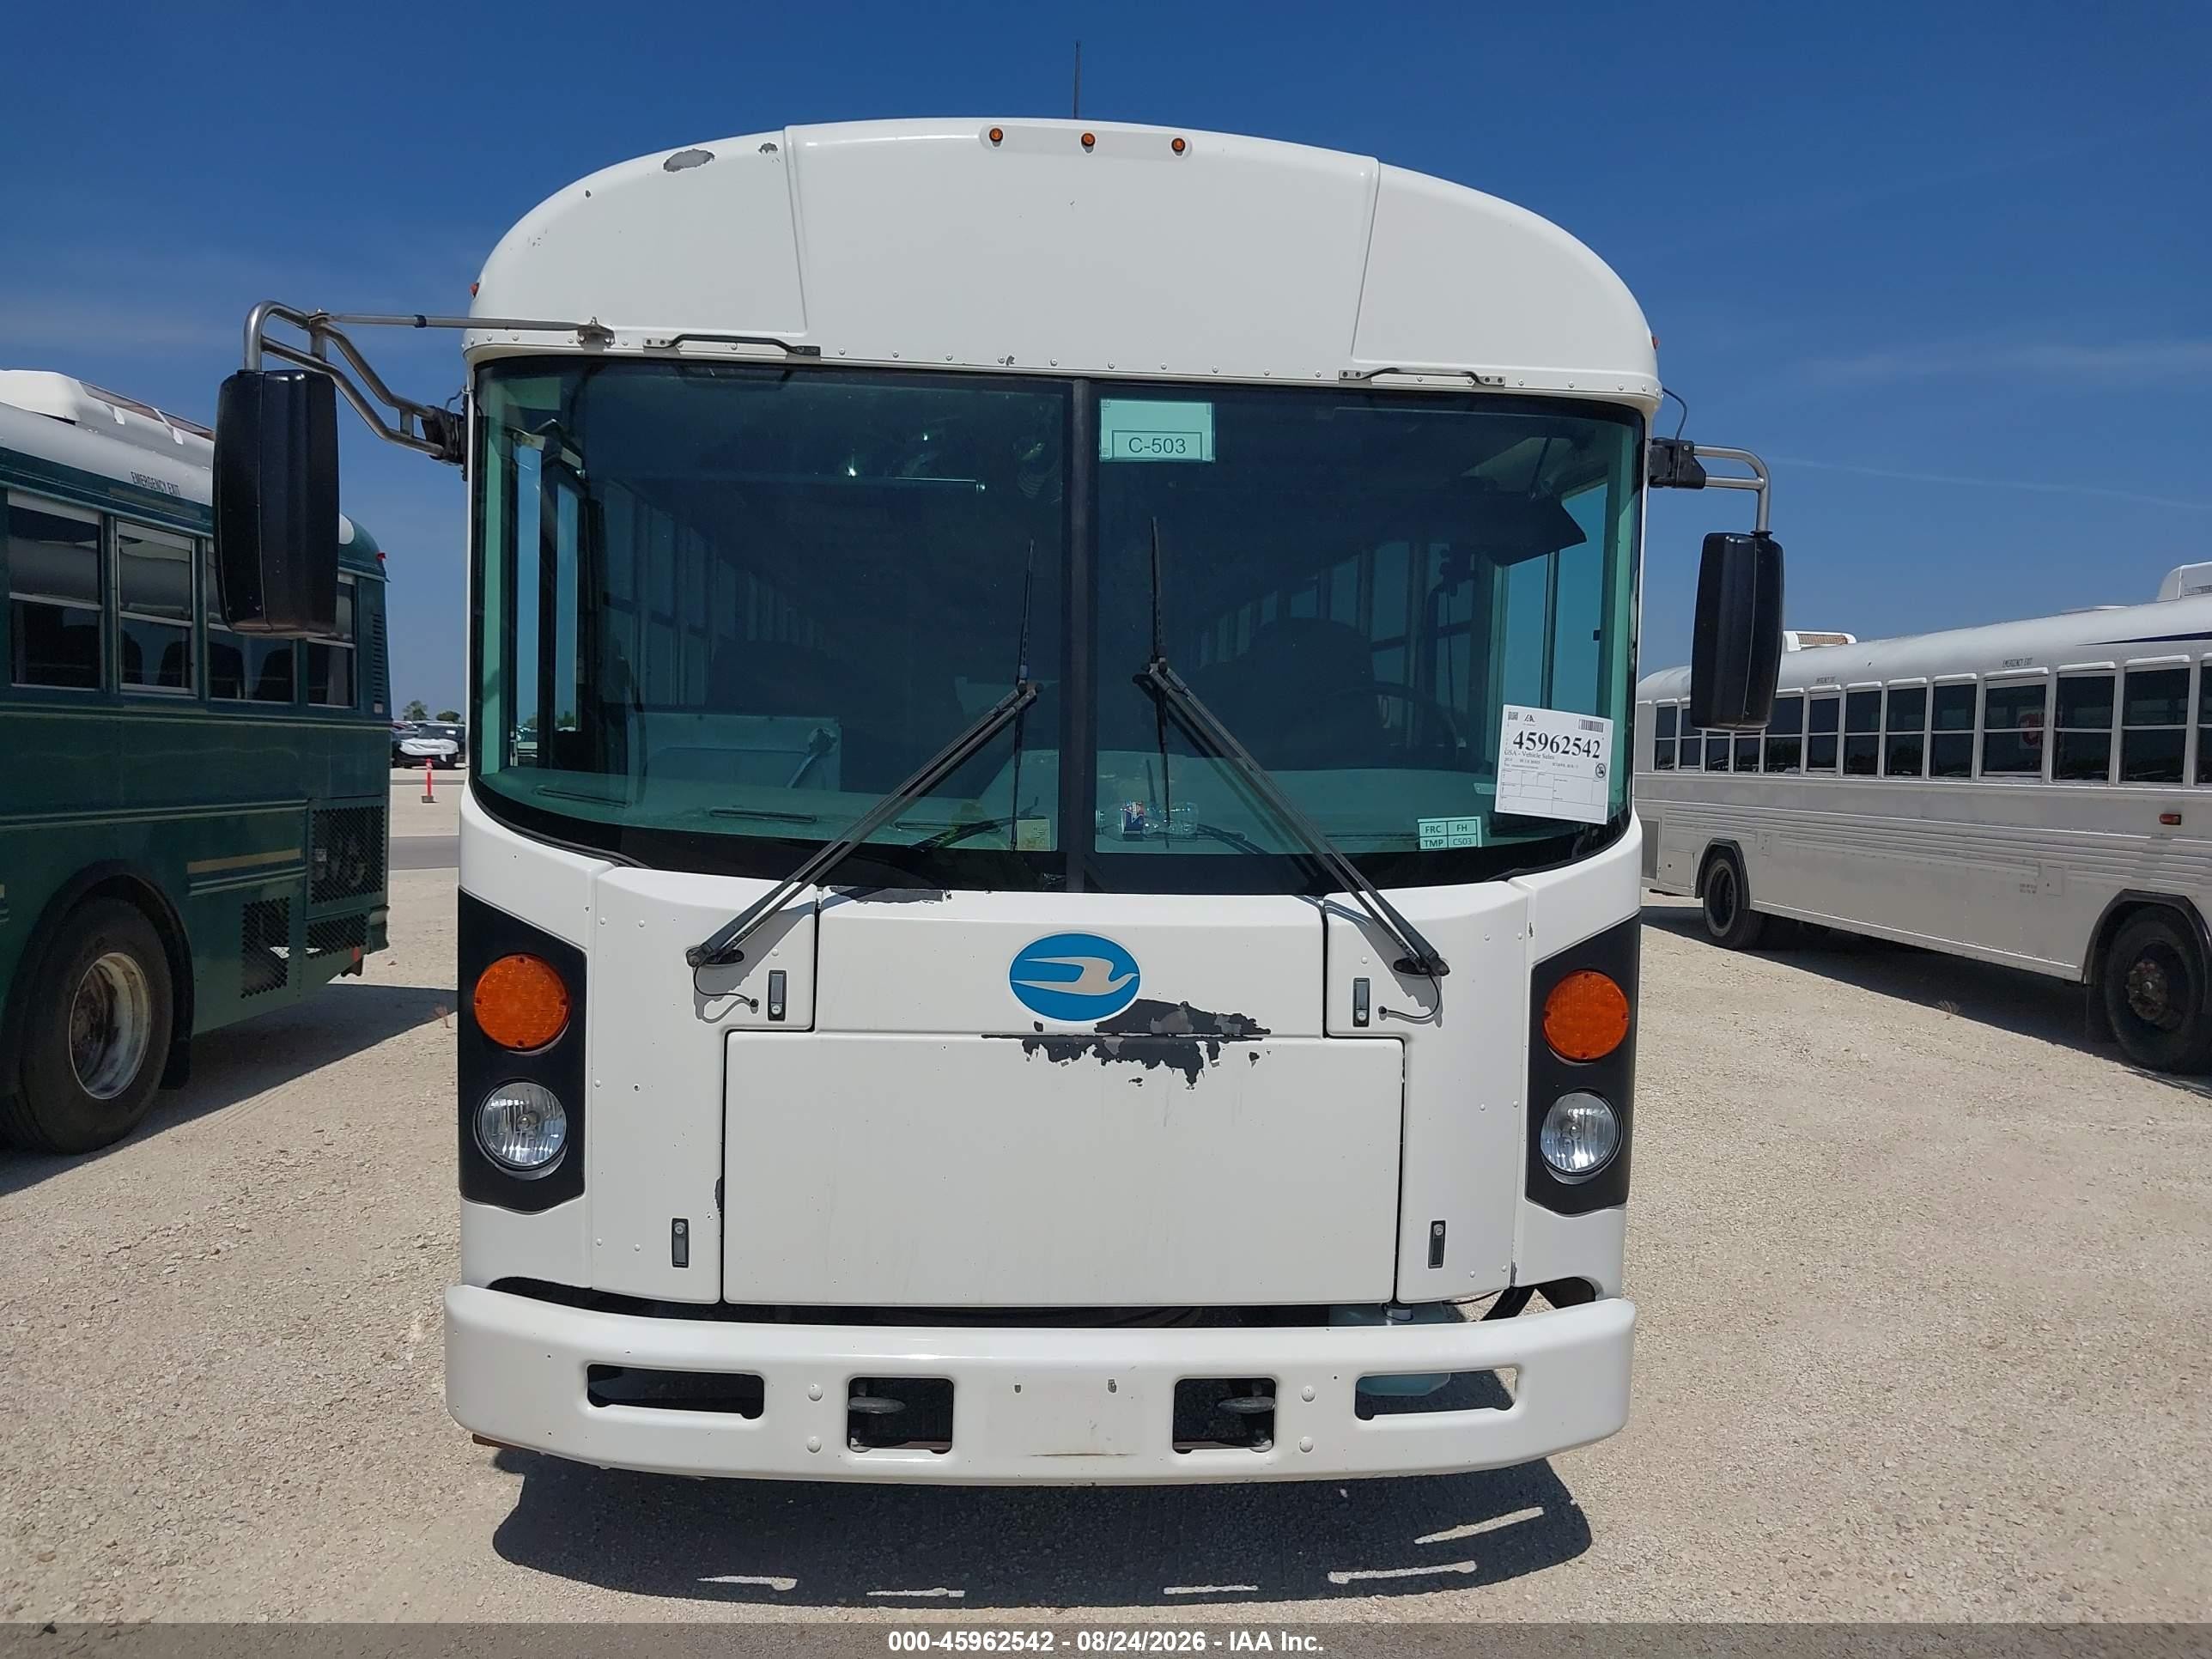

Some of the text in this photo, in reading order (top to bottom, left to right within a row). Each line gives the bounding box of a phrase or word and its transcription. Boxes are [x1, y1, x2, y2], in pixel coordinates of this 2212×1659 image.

[1128, 437, 1186, 454] C-503
[131, 471, 180, 496] EMERGENCY EXIT
[1512, 730, 1601, 759] 45962542
[1425, 825, 1442, 834] FRC
[1424, 839, 1444, 848] TMP
